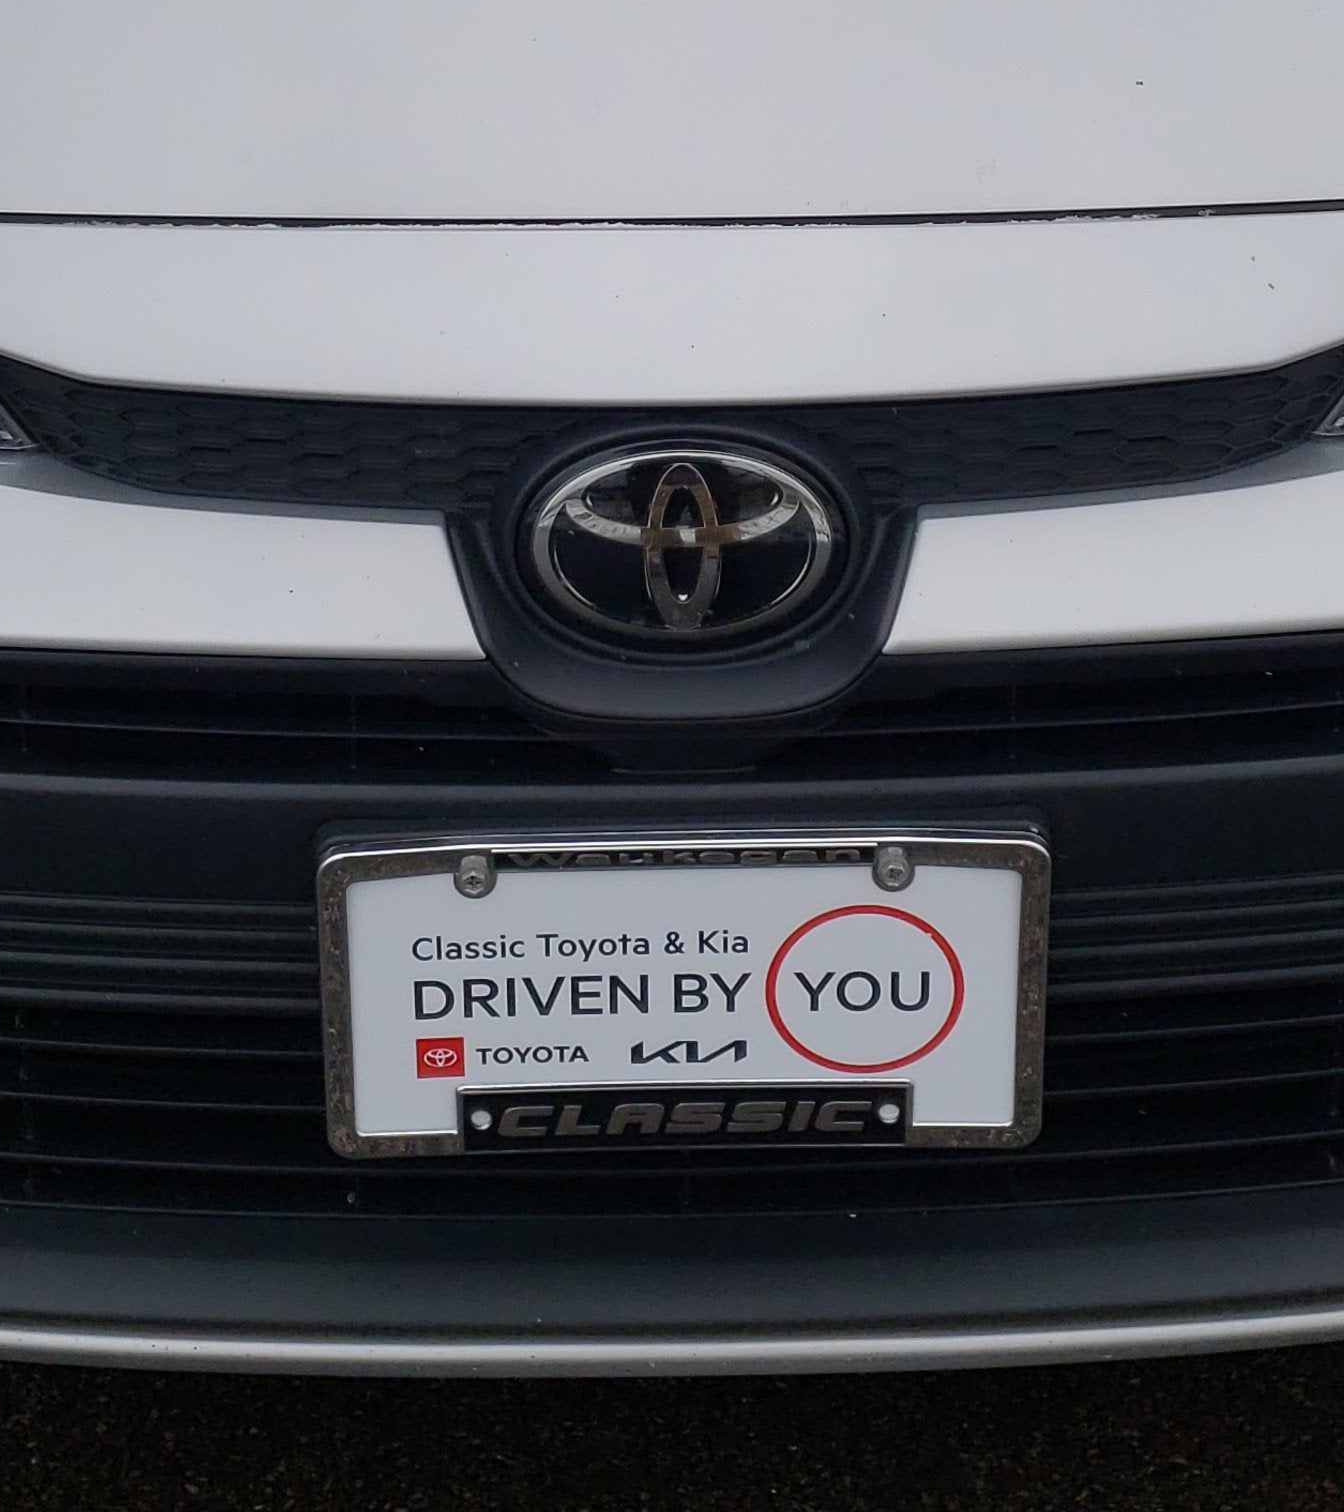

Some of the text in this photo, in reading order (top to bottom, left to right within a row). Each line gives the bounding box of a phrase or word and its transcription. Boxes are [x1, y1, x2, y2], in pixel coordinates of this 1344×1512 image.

[411, 929, 750, 962] Classic Toyota & Kia
[413, 970, 931, 1020] DRIVEN BY YOU
[475, 1045, 590, 1065] TOYOTA
[497, 1100, 873, 1138] CLASSIC
